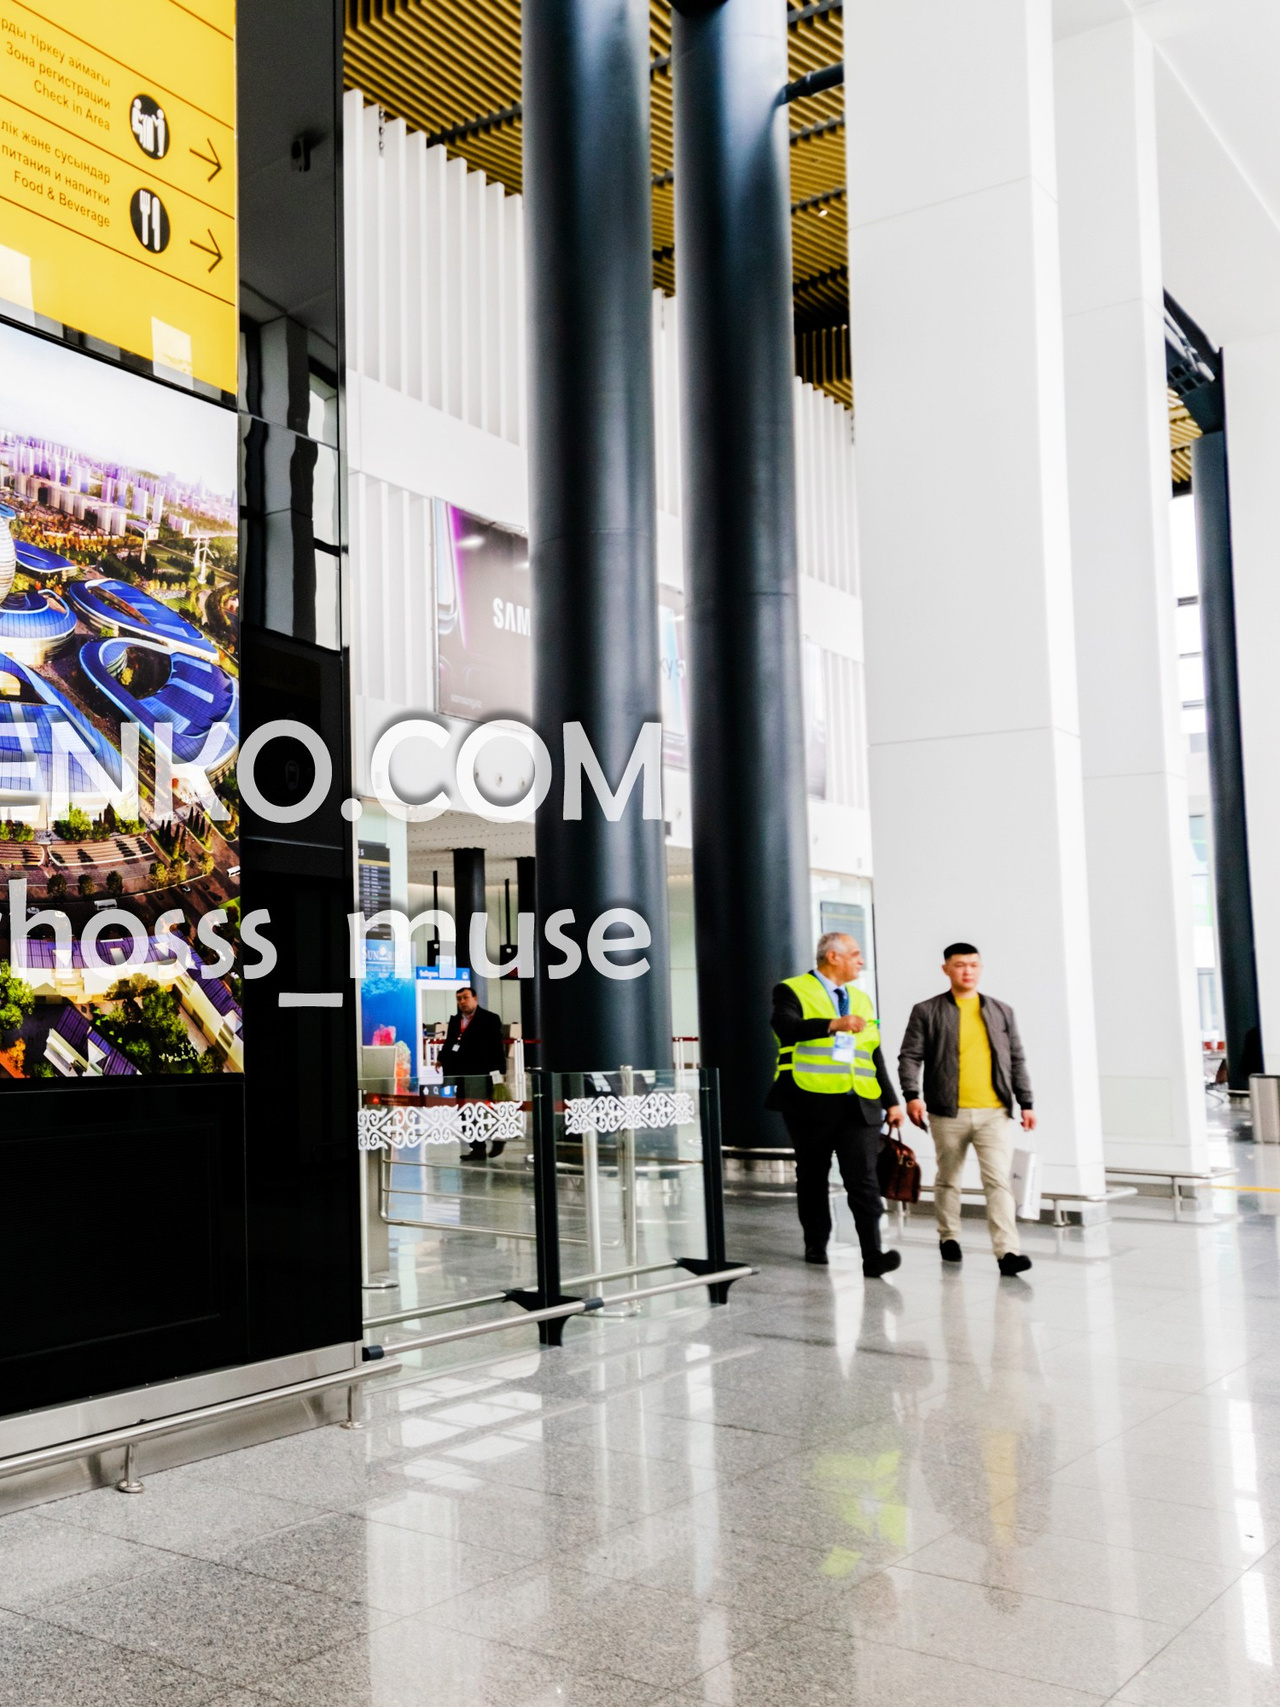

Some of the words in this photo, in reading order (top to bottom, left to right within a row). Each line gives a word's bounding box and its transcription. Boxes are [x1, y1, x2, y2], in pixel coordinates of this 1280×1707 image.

[6, 41, 35, 68] Зона
[38, 62, 111, 110] регистрации
[30, 33, 65, 63] тіркеу
[68, 55, 111, 88] аймағы
[33, 79, 69, 109] Check
[72, 103, 83, 116] in
[85, 108, 111, 131] Area
[1, 143, 51, 177] питания
[54, 170, 61, 182] и
[64, 175, 111, 206] напитки
[22, 130, 51, 153] және
[54, 147, 111, 185] сусындар
[14, 170, 44, 195] Food
[47, 186, 56, 201] &
[58, 192, 111, 228] Beverage
[493, 597, 531, 637] SAM
